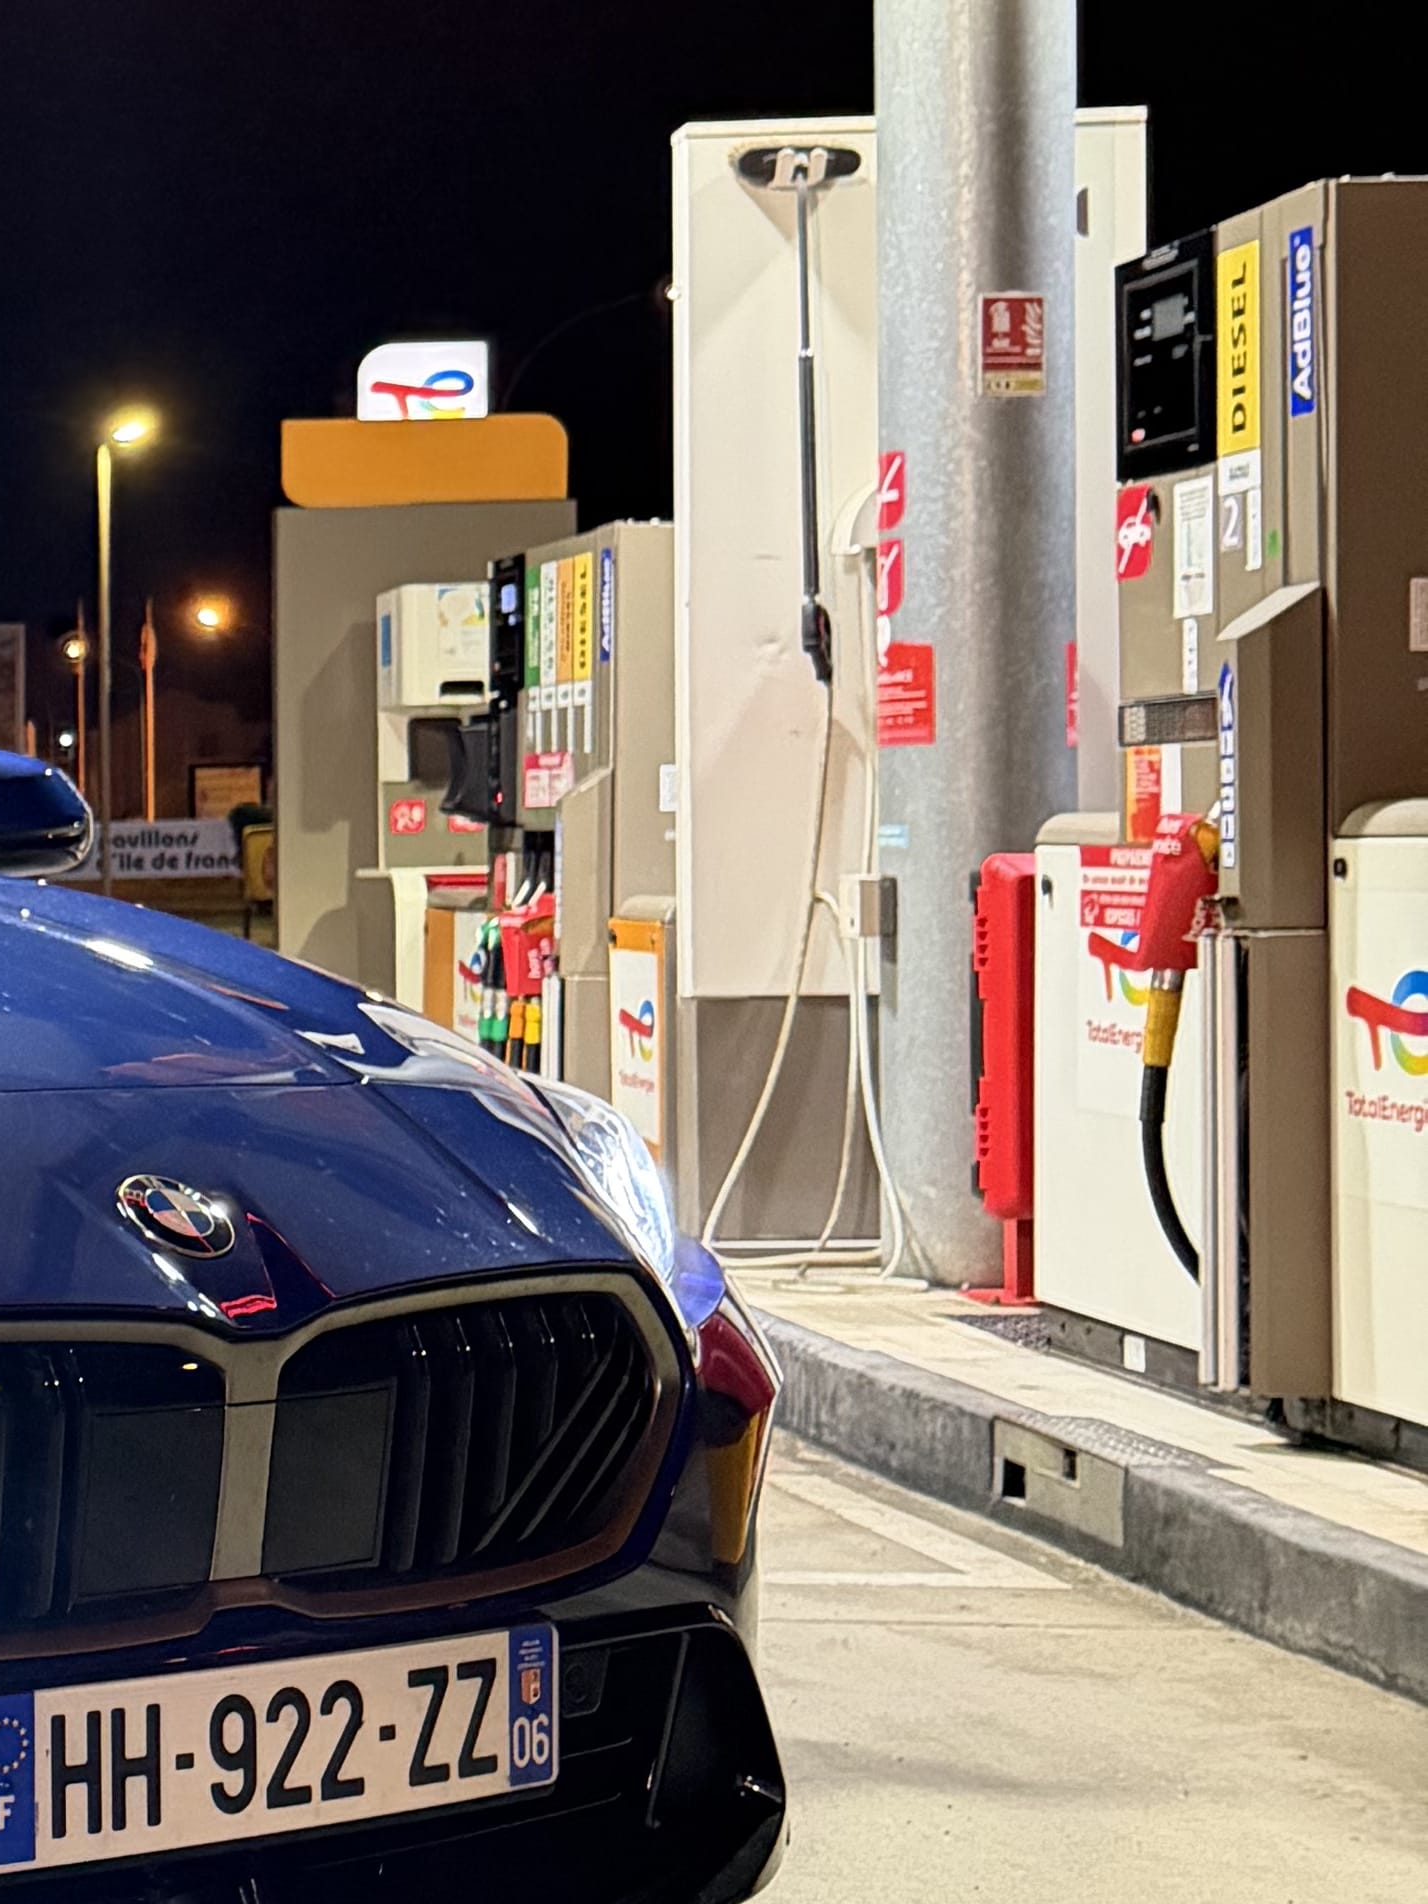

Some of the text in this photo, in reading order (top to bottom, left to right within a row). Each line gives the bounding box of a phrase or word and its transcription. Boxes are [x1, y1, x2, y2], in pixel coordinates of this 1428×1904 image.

[1231, 260, 1247, 435] DIESEL
[1292, 244, 1312, 401] AdBlue
[1223, 496, 1239, 547] 2
[578, 562, 587, 670] DIESEL
[99, 830, 199, 850] avillons
[151, 851, 179, 871] de
[1086, 1019, 1144, 1054] TotalEnerg
[50, 1657, 500, 1839] HH-922-ZZ
[512, 1712, 550, 1769] 06
